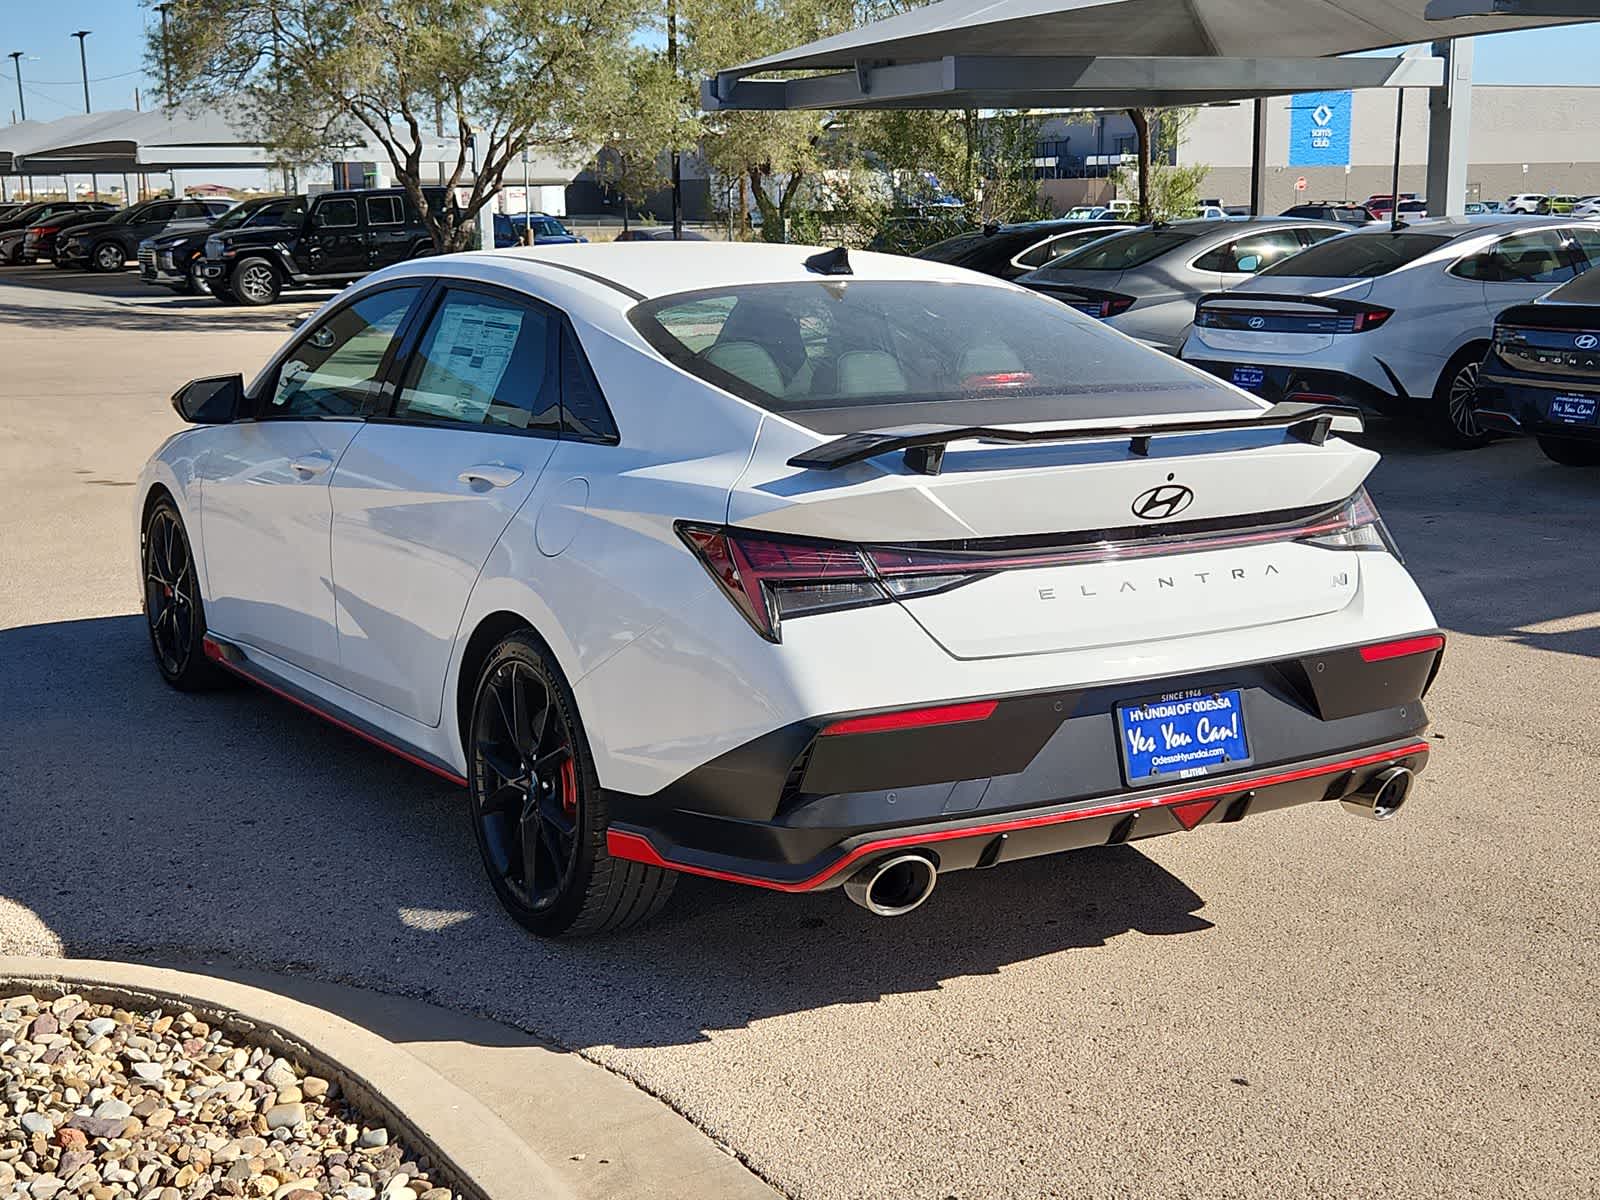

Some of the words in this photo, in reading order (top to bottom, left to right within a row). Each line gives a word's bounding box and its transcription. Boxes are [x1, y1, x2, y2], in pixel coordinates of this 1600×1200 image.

[1038, 564, 1279, 600] ELANTRA
[1161, 691, 1184, 702] SINCE
[1130, 707, 1176, 722] HYUNDAI
[1177, 702, 1192, 715] OF
[1193, 697, 1231, 713] ODESSA
[1127, 727, 1156, 755] Yes
[1161, 722, 1192, 750] You
[1197, 712, 1238, 744] Can!
[1152, 748, 1224, 765] OdessaHyundai.com
